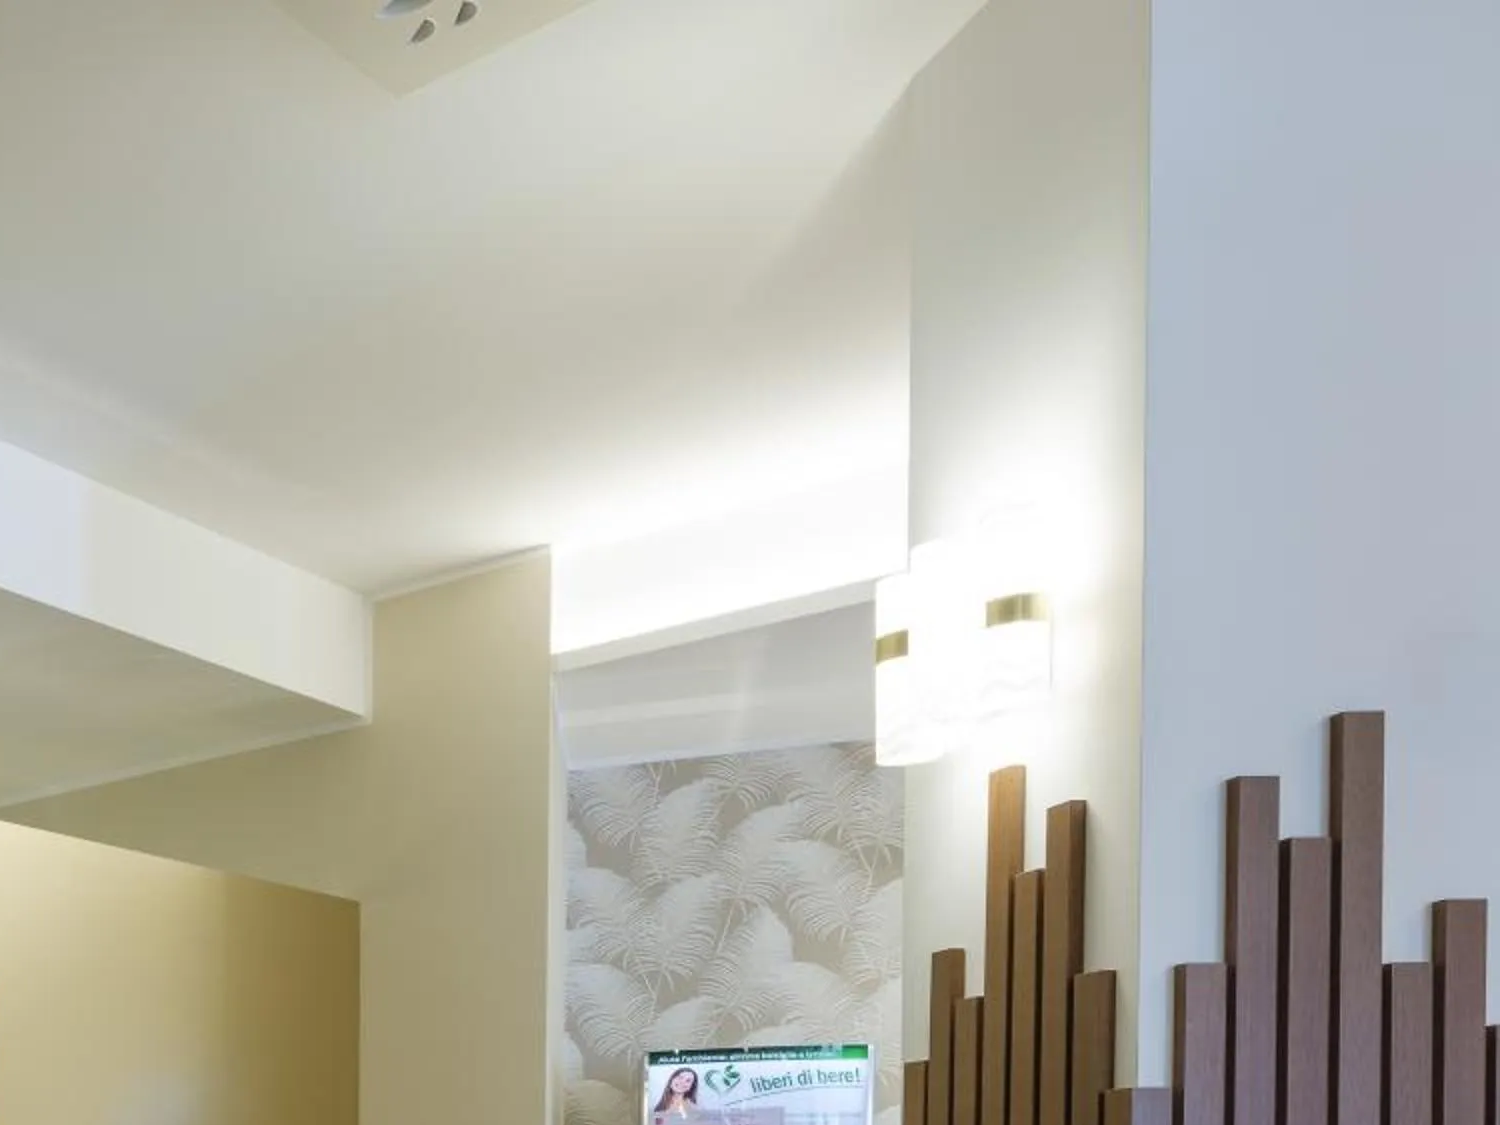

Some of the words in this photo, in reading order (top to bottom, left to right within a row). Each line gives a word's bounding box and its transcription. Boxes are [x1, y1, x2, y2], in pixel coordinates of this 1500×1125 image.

[749, 1071, 793, 1093] liberi
[797, 1069, 813, 1085] di
[817, 1067, 860, 1084] bere!
